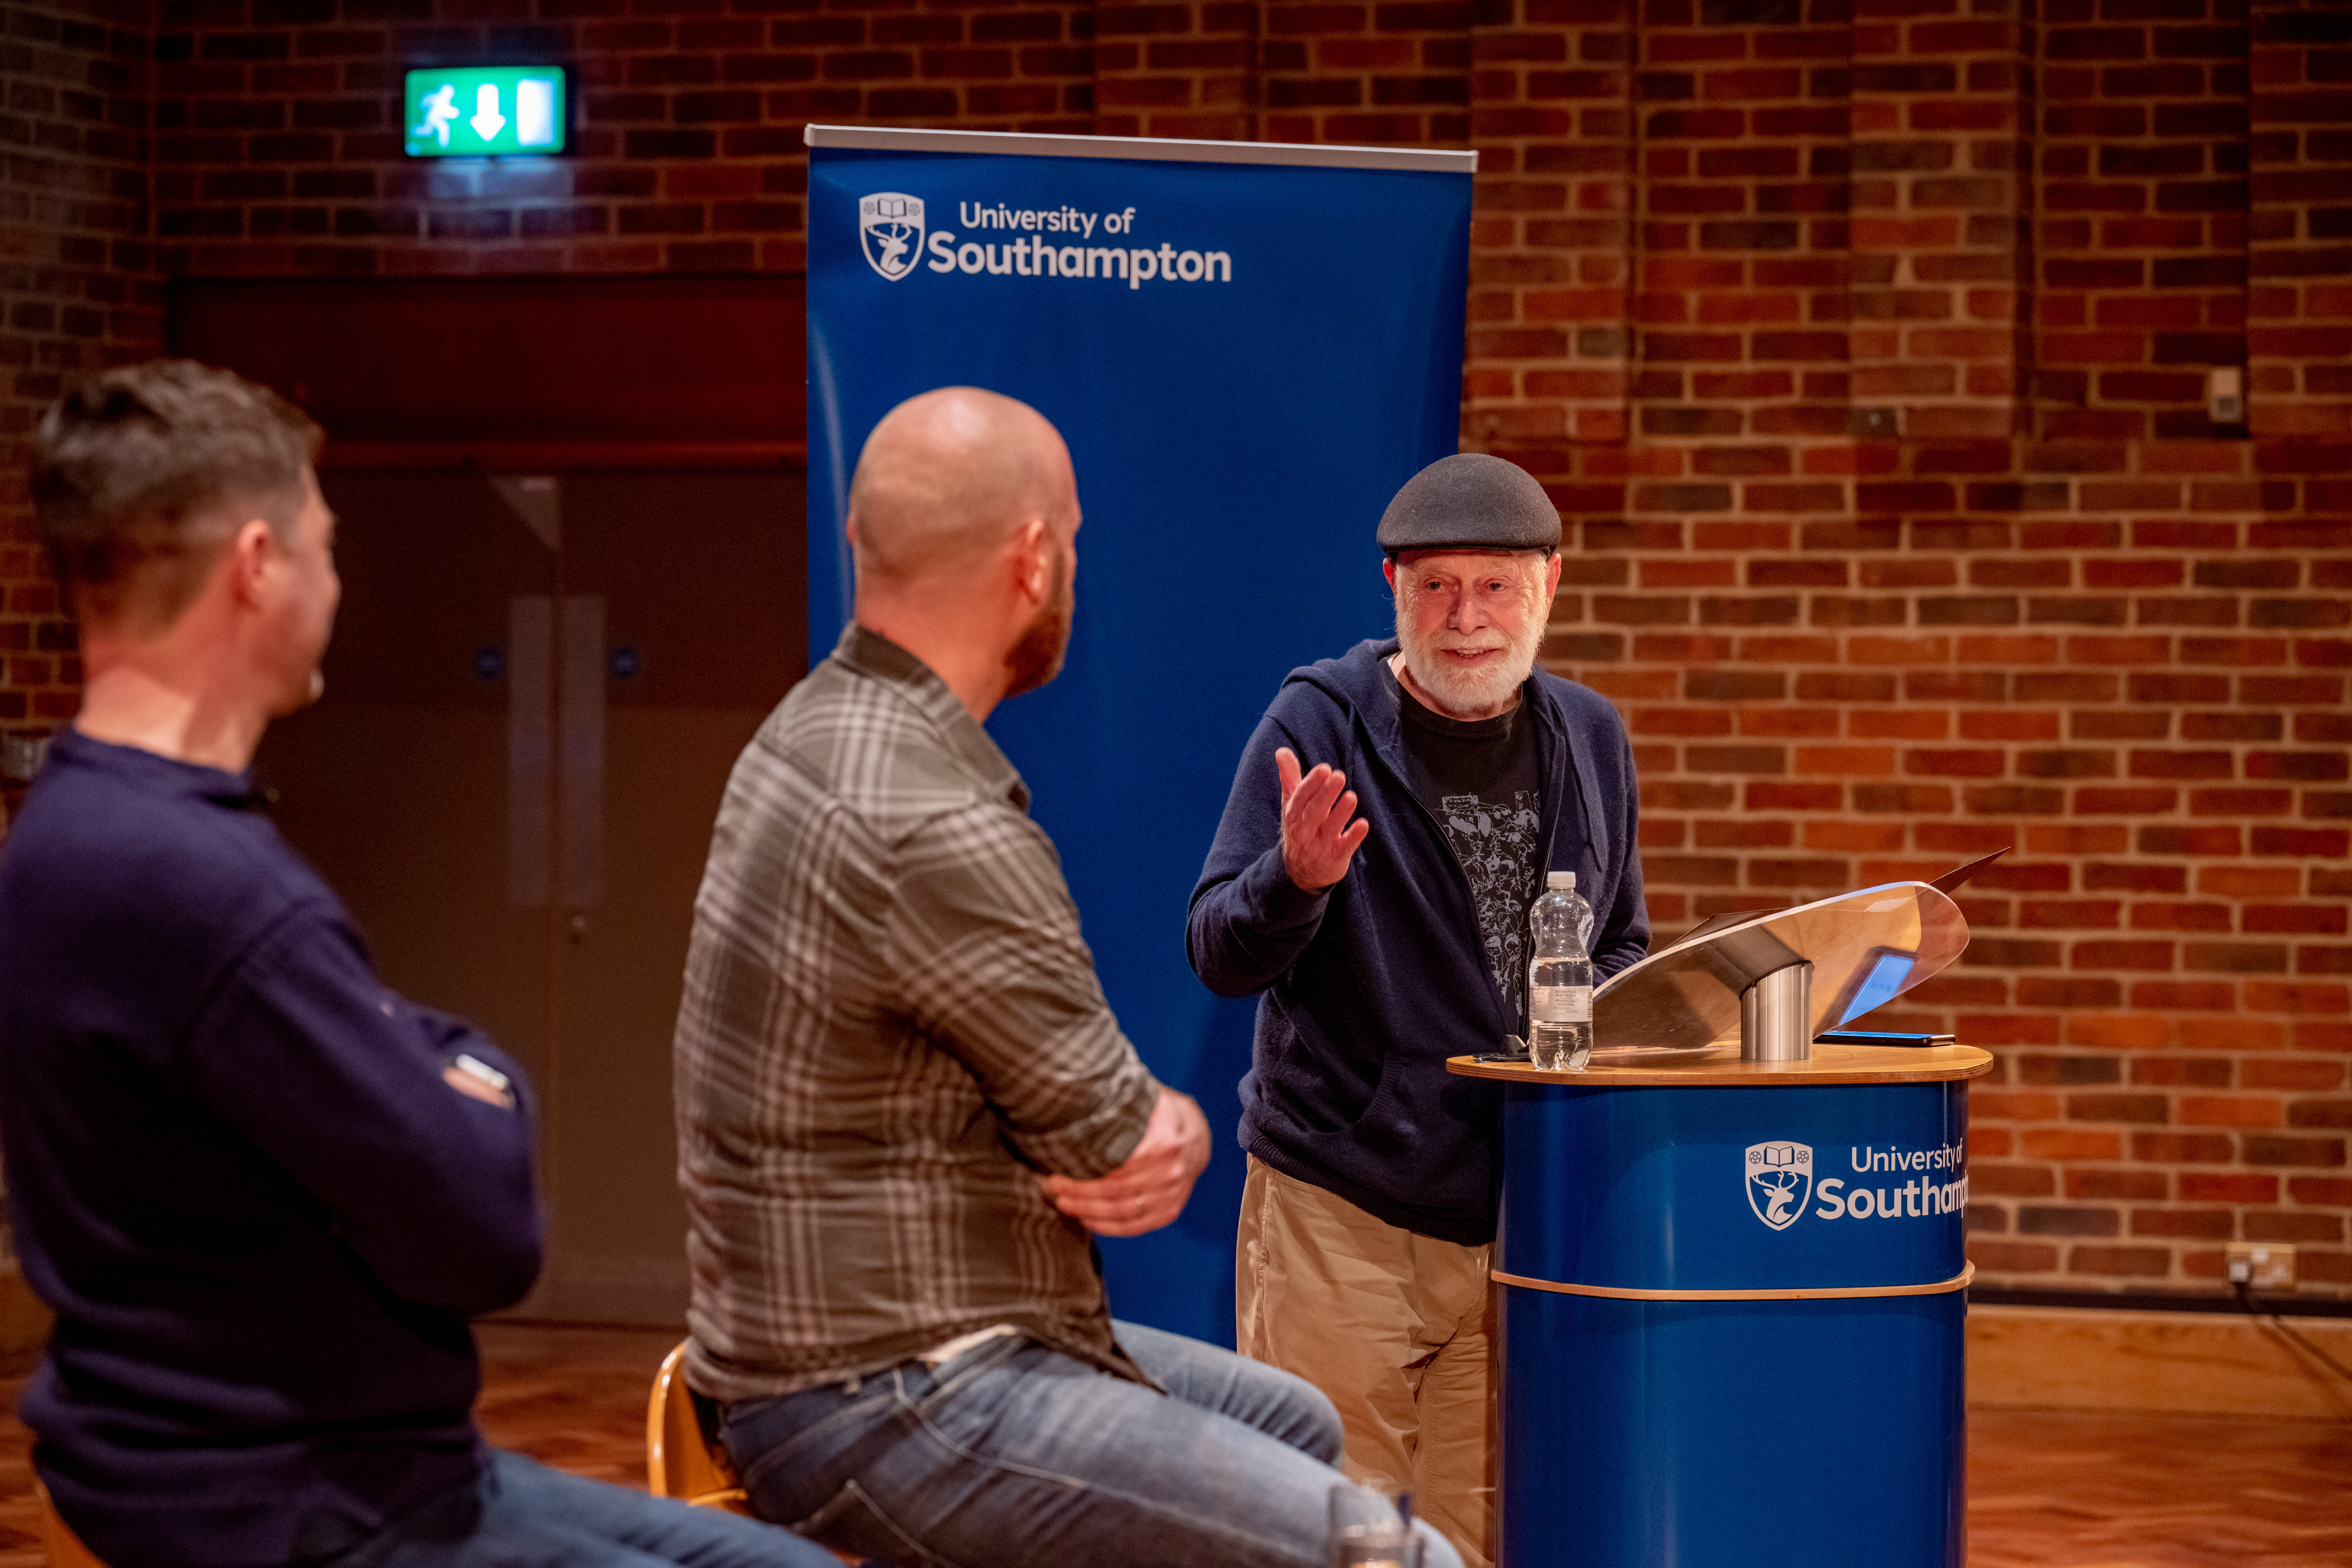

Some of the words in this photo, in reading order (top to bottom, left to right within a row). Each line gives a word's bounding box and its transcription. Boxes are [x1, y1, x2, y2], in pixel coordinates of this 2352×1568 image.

[960, 201, 1097, 239] University
[1104, 207, 1136, 234] of
[928, 231, 1231, 290] Southampton
[1852, 1143, 1955, 1172] University
[1956, 1137, 1963, 1164] of
[1816, 1169, 1968, 1220] Southampt
